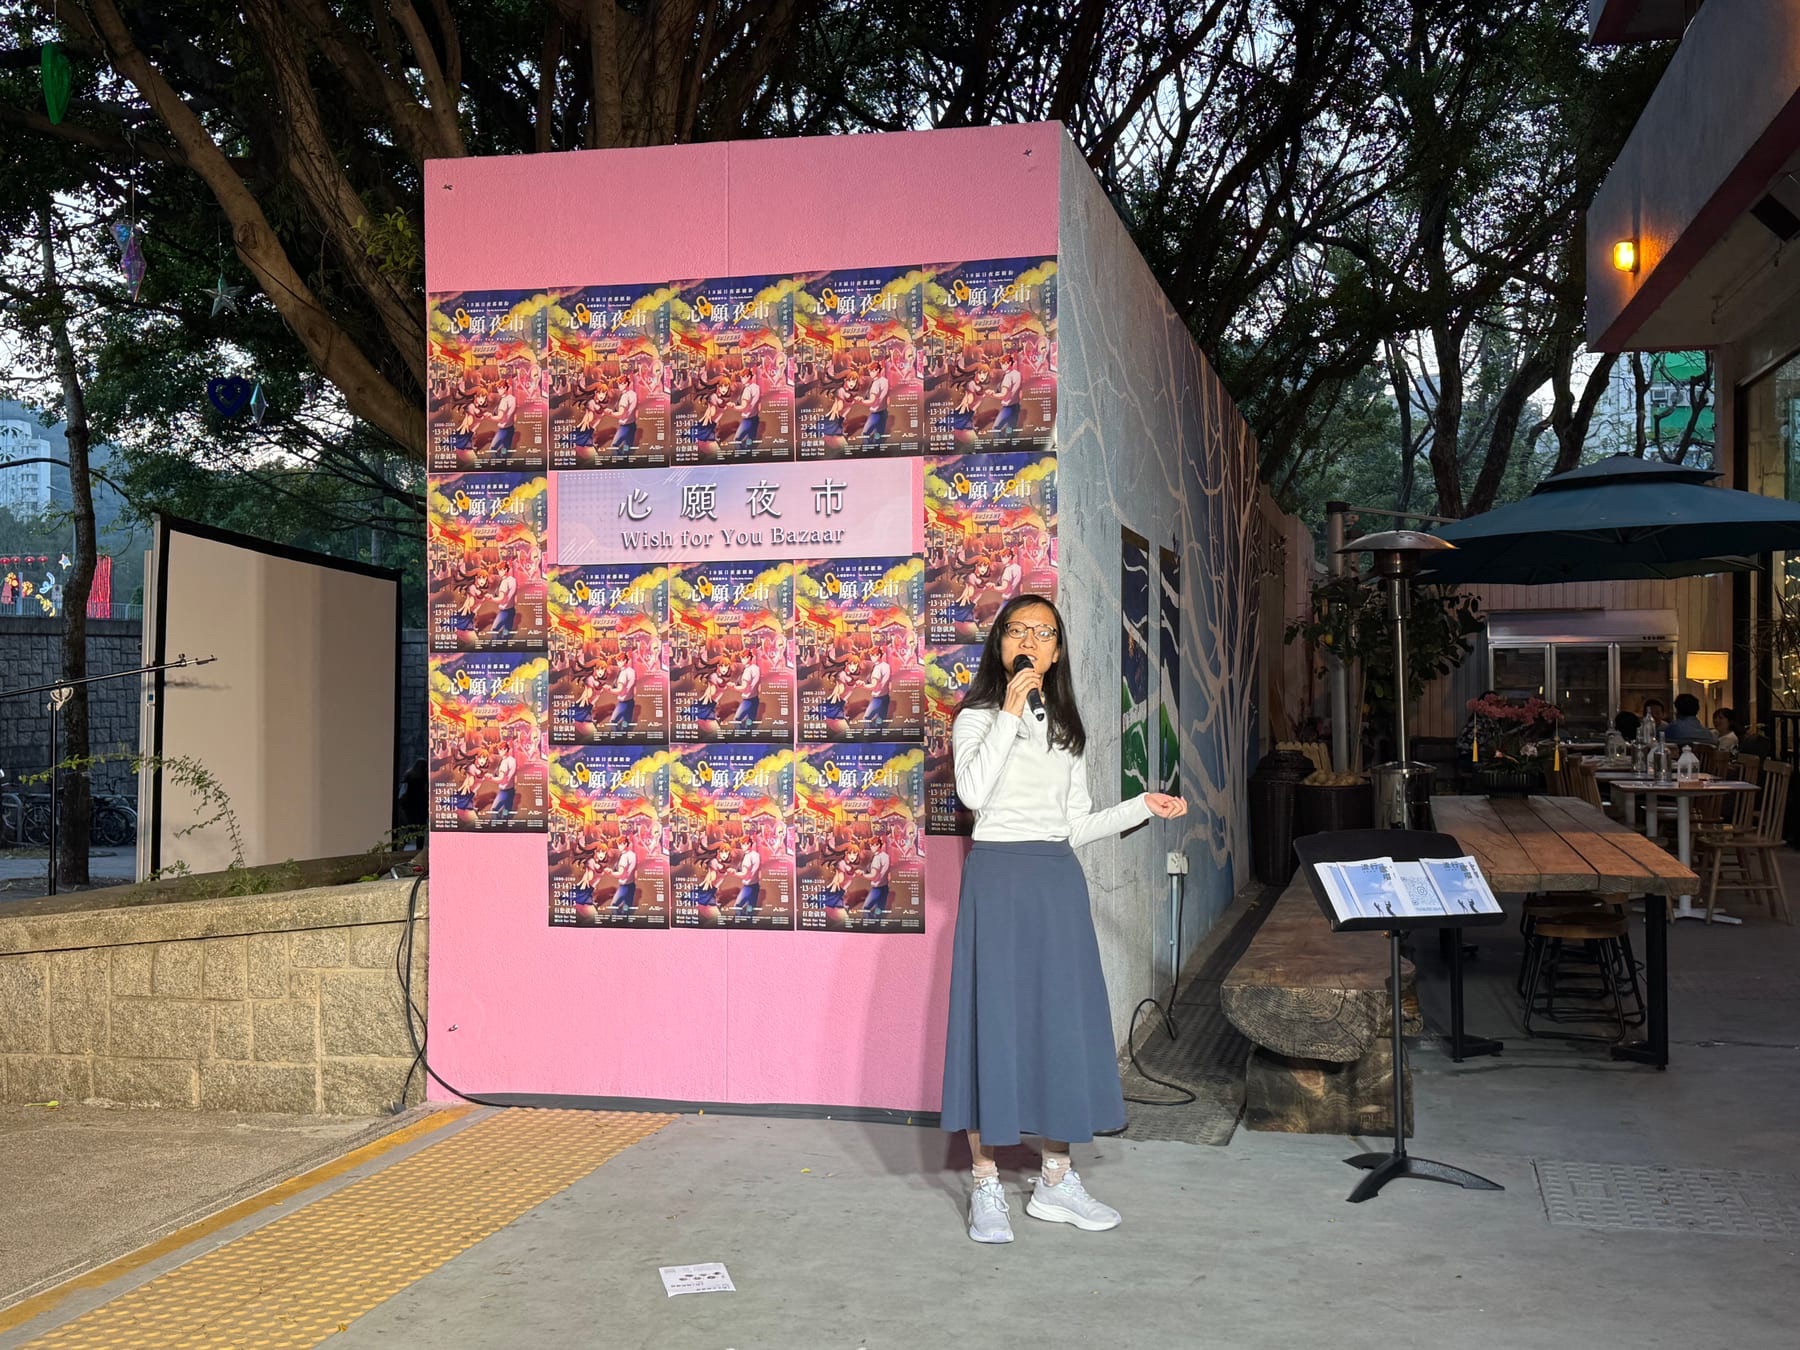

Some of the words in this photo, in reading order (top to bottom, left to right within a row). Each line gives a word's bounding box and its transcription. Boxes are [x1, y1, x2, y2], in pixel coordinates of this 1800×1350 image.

[812, 292, 898, 316] 心願夜市
[942, 283, 1031, 308] 心願夜市
[566, 308, 646, 330] 心願夜市
[686, 300, 769, 323] 心願夜市
[446, 313, 524, 334] 心願夜市
[618, 477, 848, 521] 心願夜市
[943, 478, 1031, 500] 心願夜市
[446, 496, 525, 516] 心願夜市
[621, 529, 673, 549] Wish
[681, 528, 714, 547] for
[721, 527, 763, 546] You
[771, 525, 846, 545] Bazaar
[565, 586, 645, 606] 心願夜市
[687, 582, 769, 602] 心願夜市
[814, 578, 899, 600] 心願夜市
[446, 676, 525, 695] 心願夜市
[565, 769, 646, 789] 心願夜市
[687, 768, 769, 788] 心願夜市
[814, 768, 899, 788] 心願夜市
